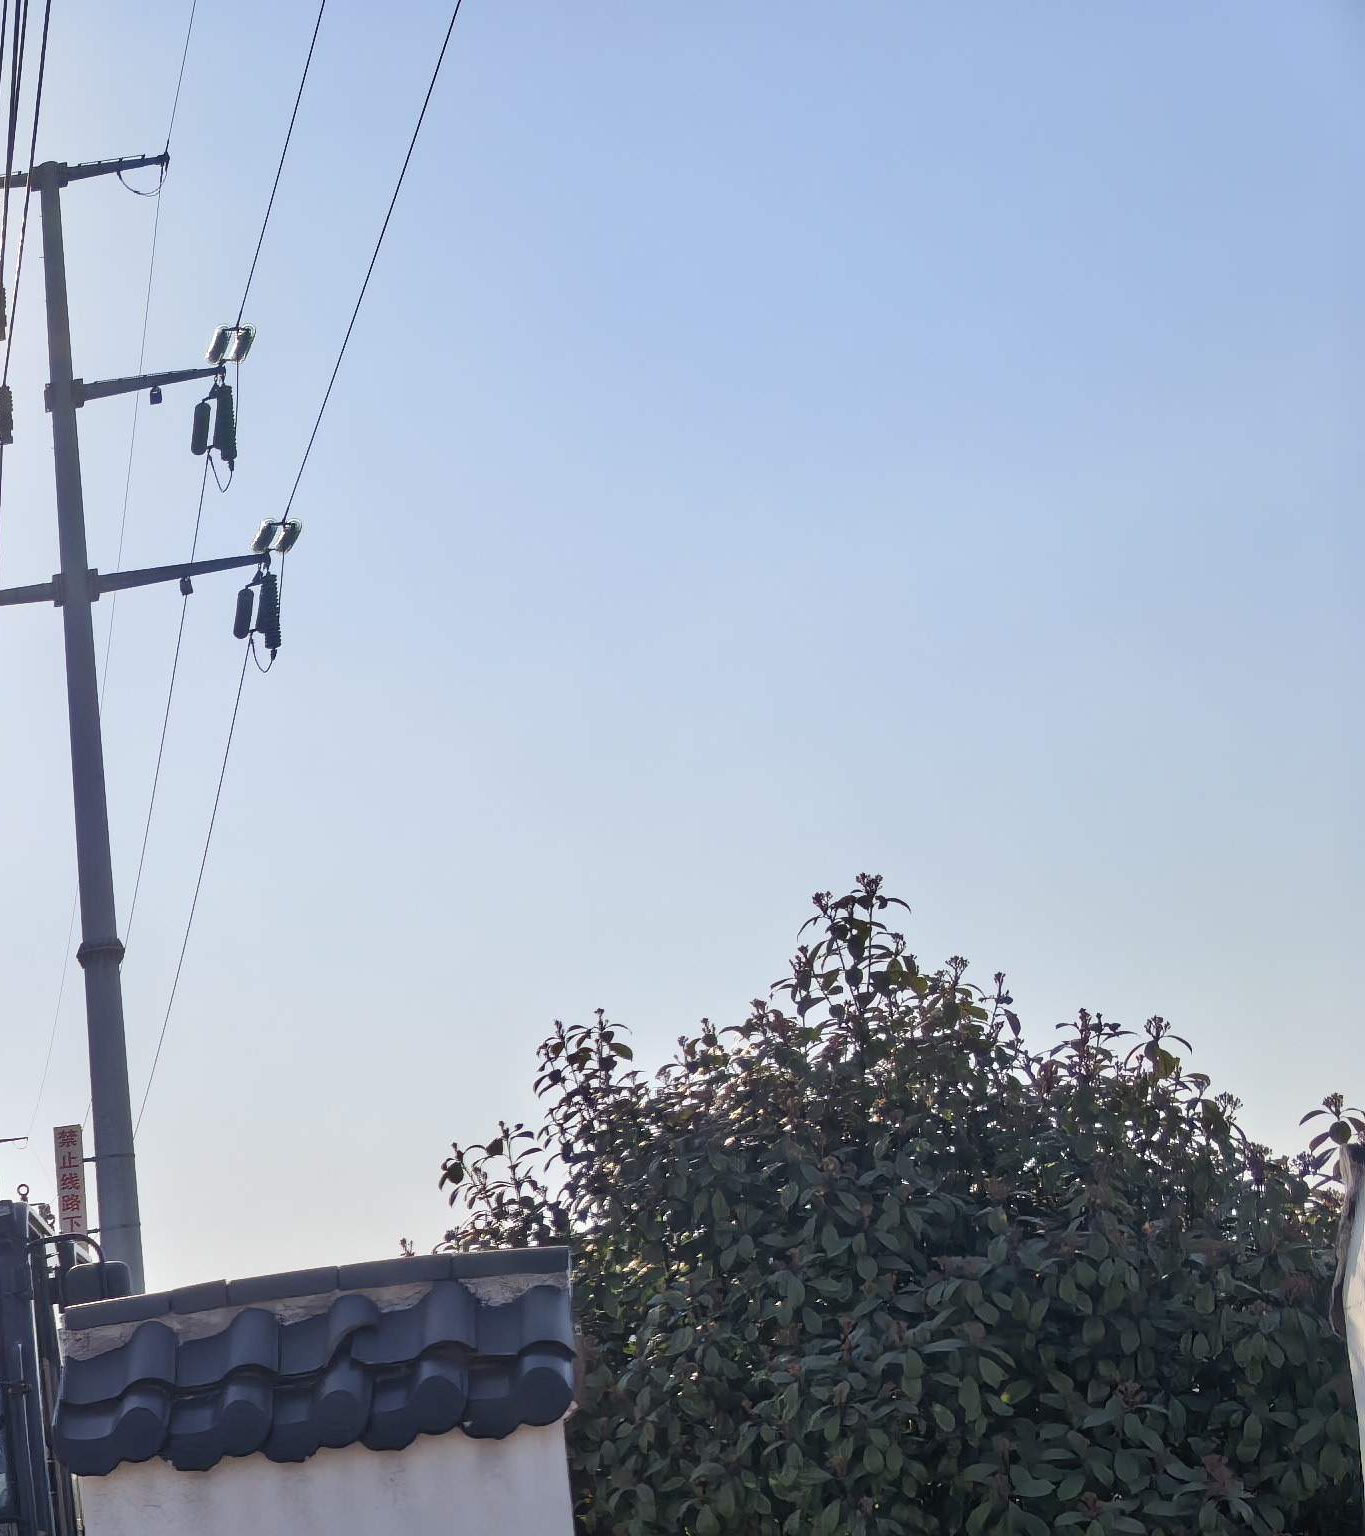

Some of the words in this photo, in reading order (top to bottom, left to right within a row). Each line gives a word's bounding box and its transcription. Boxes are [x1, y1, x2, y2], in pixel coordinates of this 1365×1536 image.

[58, 1129, 81, 1232] 禁止线路下
